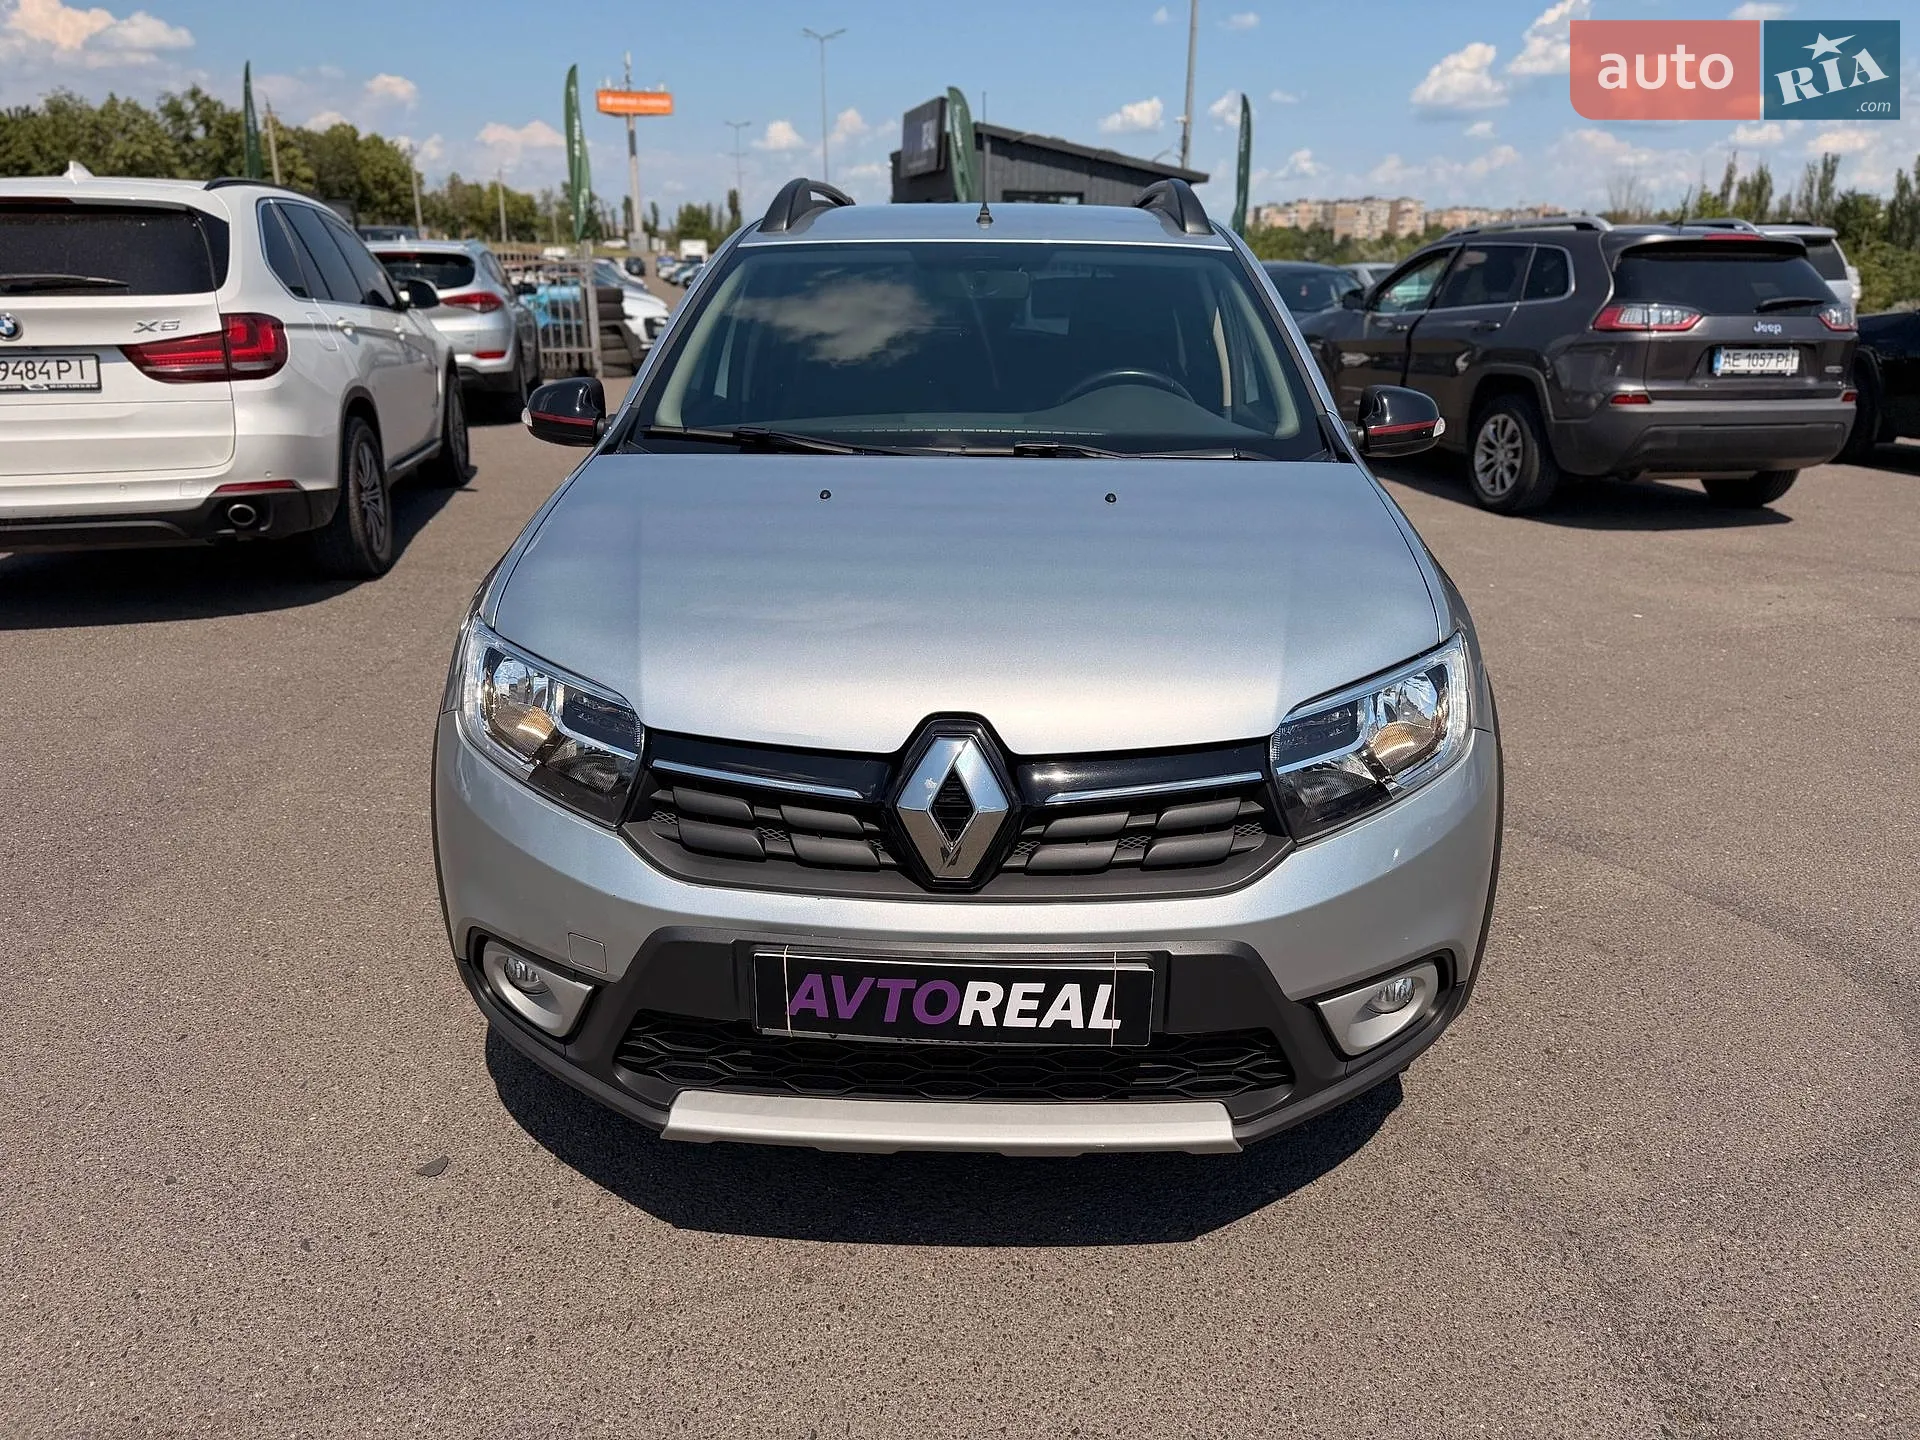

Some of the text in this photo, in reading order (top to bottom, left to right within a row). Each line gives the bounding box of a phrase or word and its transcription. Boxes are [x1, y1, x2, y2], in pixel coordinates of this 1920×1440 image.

[133, 320, 180, 334] X5
[1753, 321, 1782, 335] Jeep
[1723, 352, 1741, 368] AE
[1746, 352, 1774, 368] 1057
[0, 359, 51, 381] 9484
[789, 972, 1122, 1030] AVTOREAL
